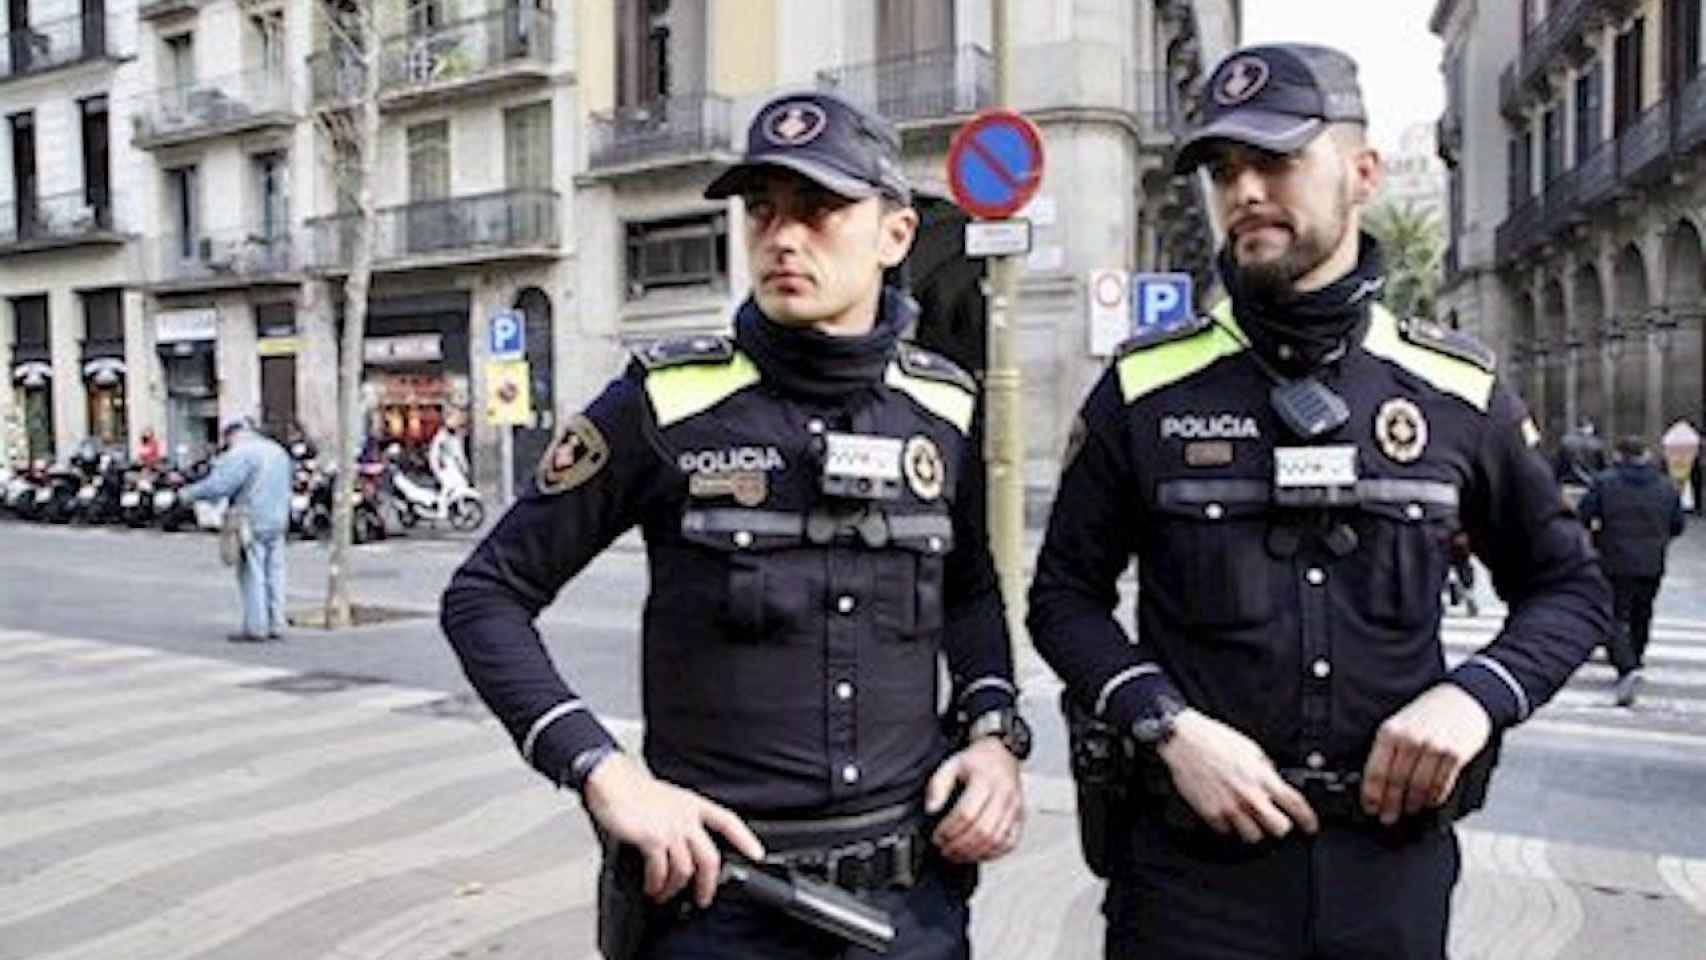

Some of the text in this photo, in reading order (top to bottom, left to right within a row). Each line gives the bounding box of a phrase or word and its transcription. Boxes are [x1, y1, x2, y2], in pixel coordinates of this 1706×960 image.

[1144, 284, 1179, 324] P
[495, 317, 517, 348] P
[1160, 414, 1260, 439] POLICIA
[679, 446, 786, 473] POLICIA
